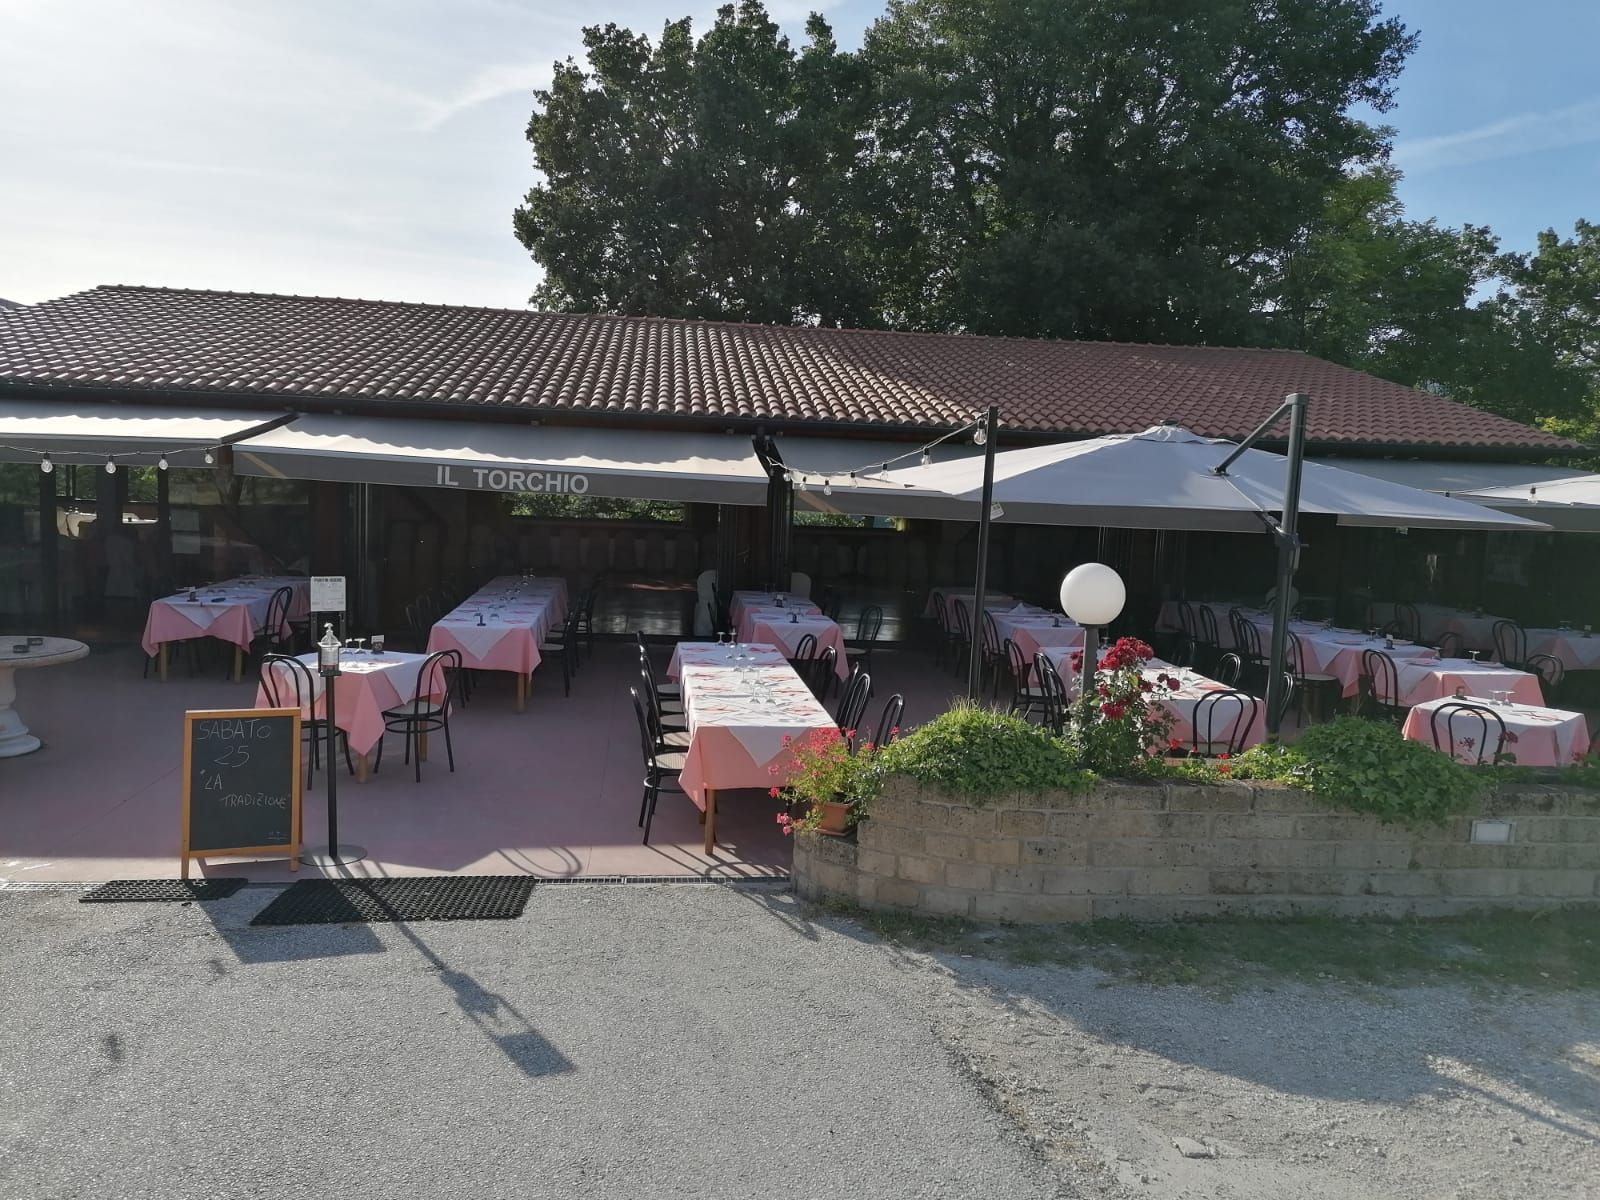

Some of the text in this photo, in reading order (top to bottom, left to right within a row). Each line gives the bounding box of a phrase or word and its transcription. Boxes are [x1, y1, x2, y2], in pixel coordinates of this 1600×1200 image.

[436, 465, 589, 494] IL TORCHIO
[197, 718, 272, 740] SABATO
[213, 745, 250, 768] 25
